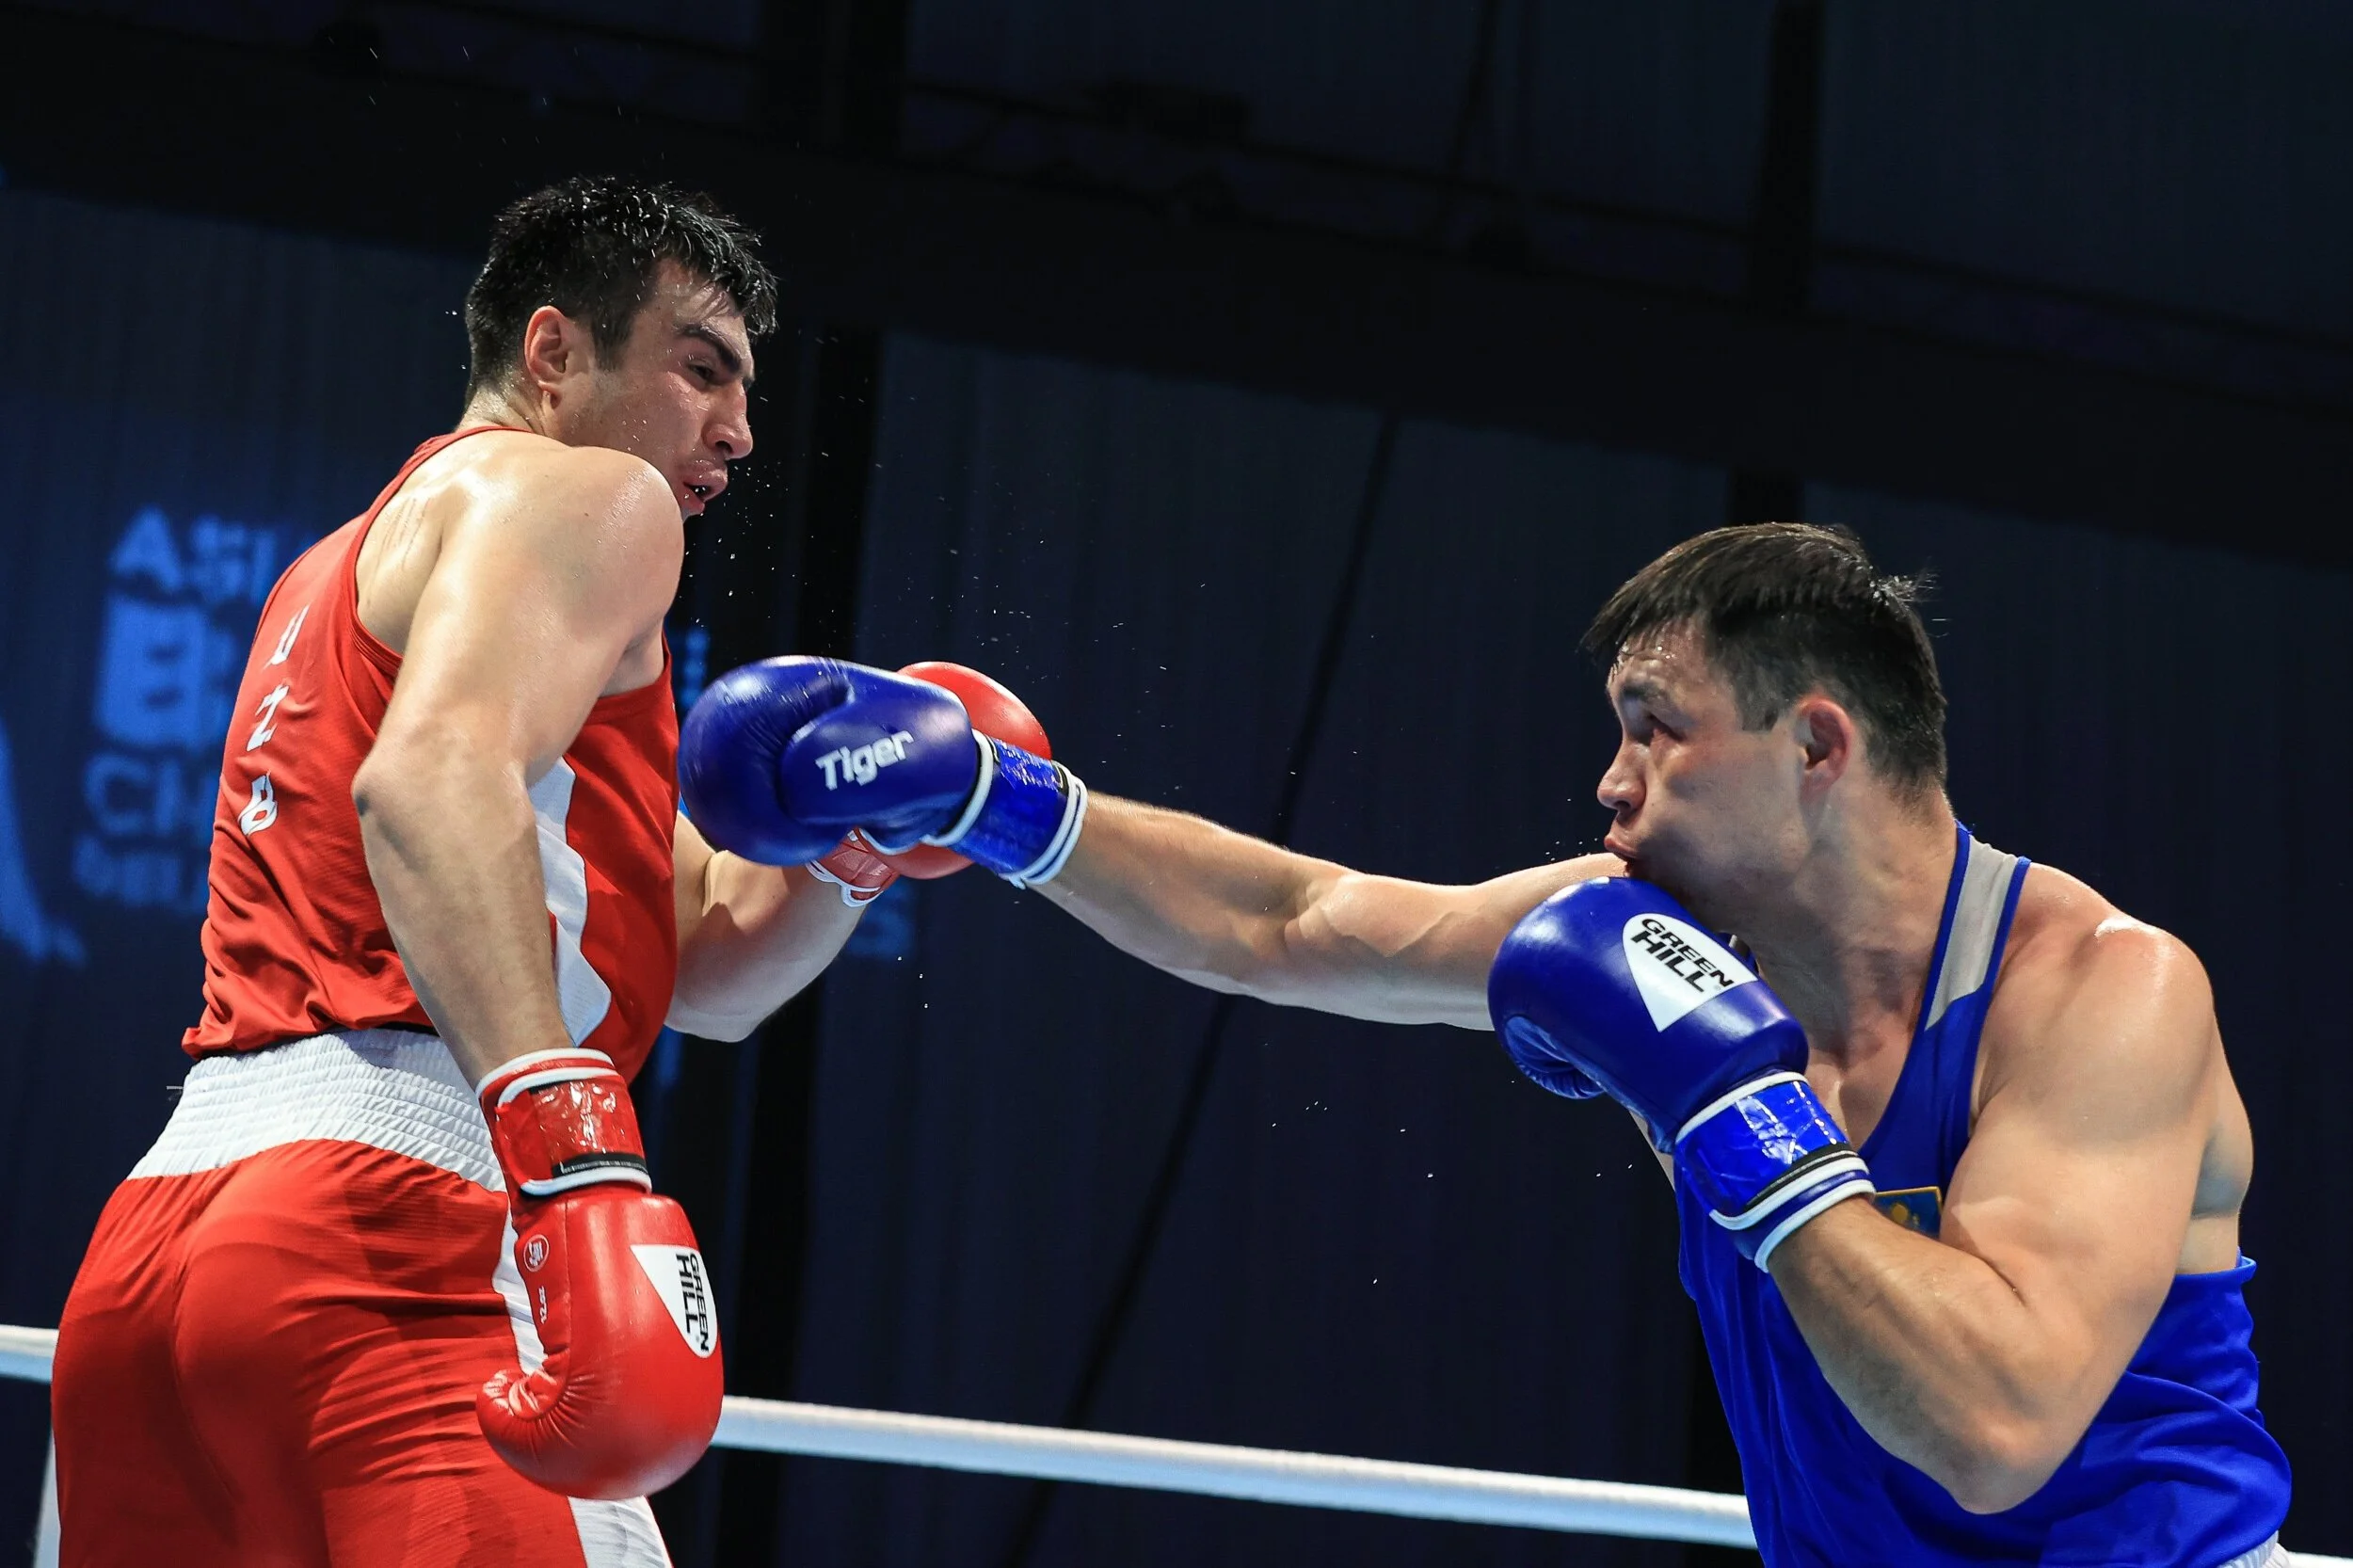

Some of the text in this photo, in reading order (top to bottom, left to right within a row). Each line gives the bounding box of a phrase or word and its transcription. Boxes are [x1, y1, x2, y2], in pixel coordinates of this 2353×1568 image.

[815, 729, 914, 791] Tiger
[1631, 930, 1705, 992] HILL
[1641, 918, 1734, 987] GREEN
[676, 1253, 698, 1334] HILL
[689, 1253, 710, 1352] GREEN
